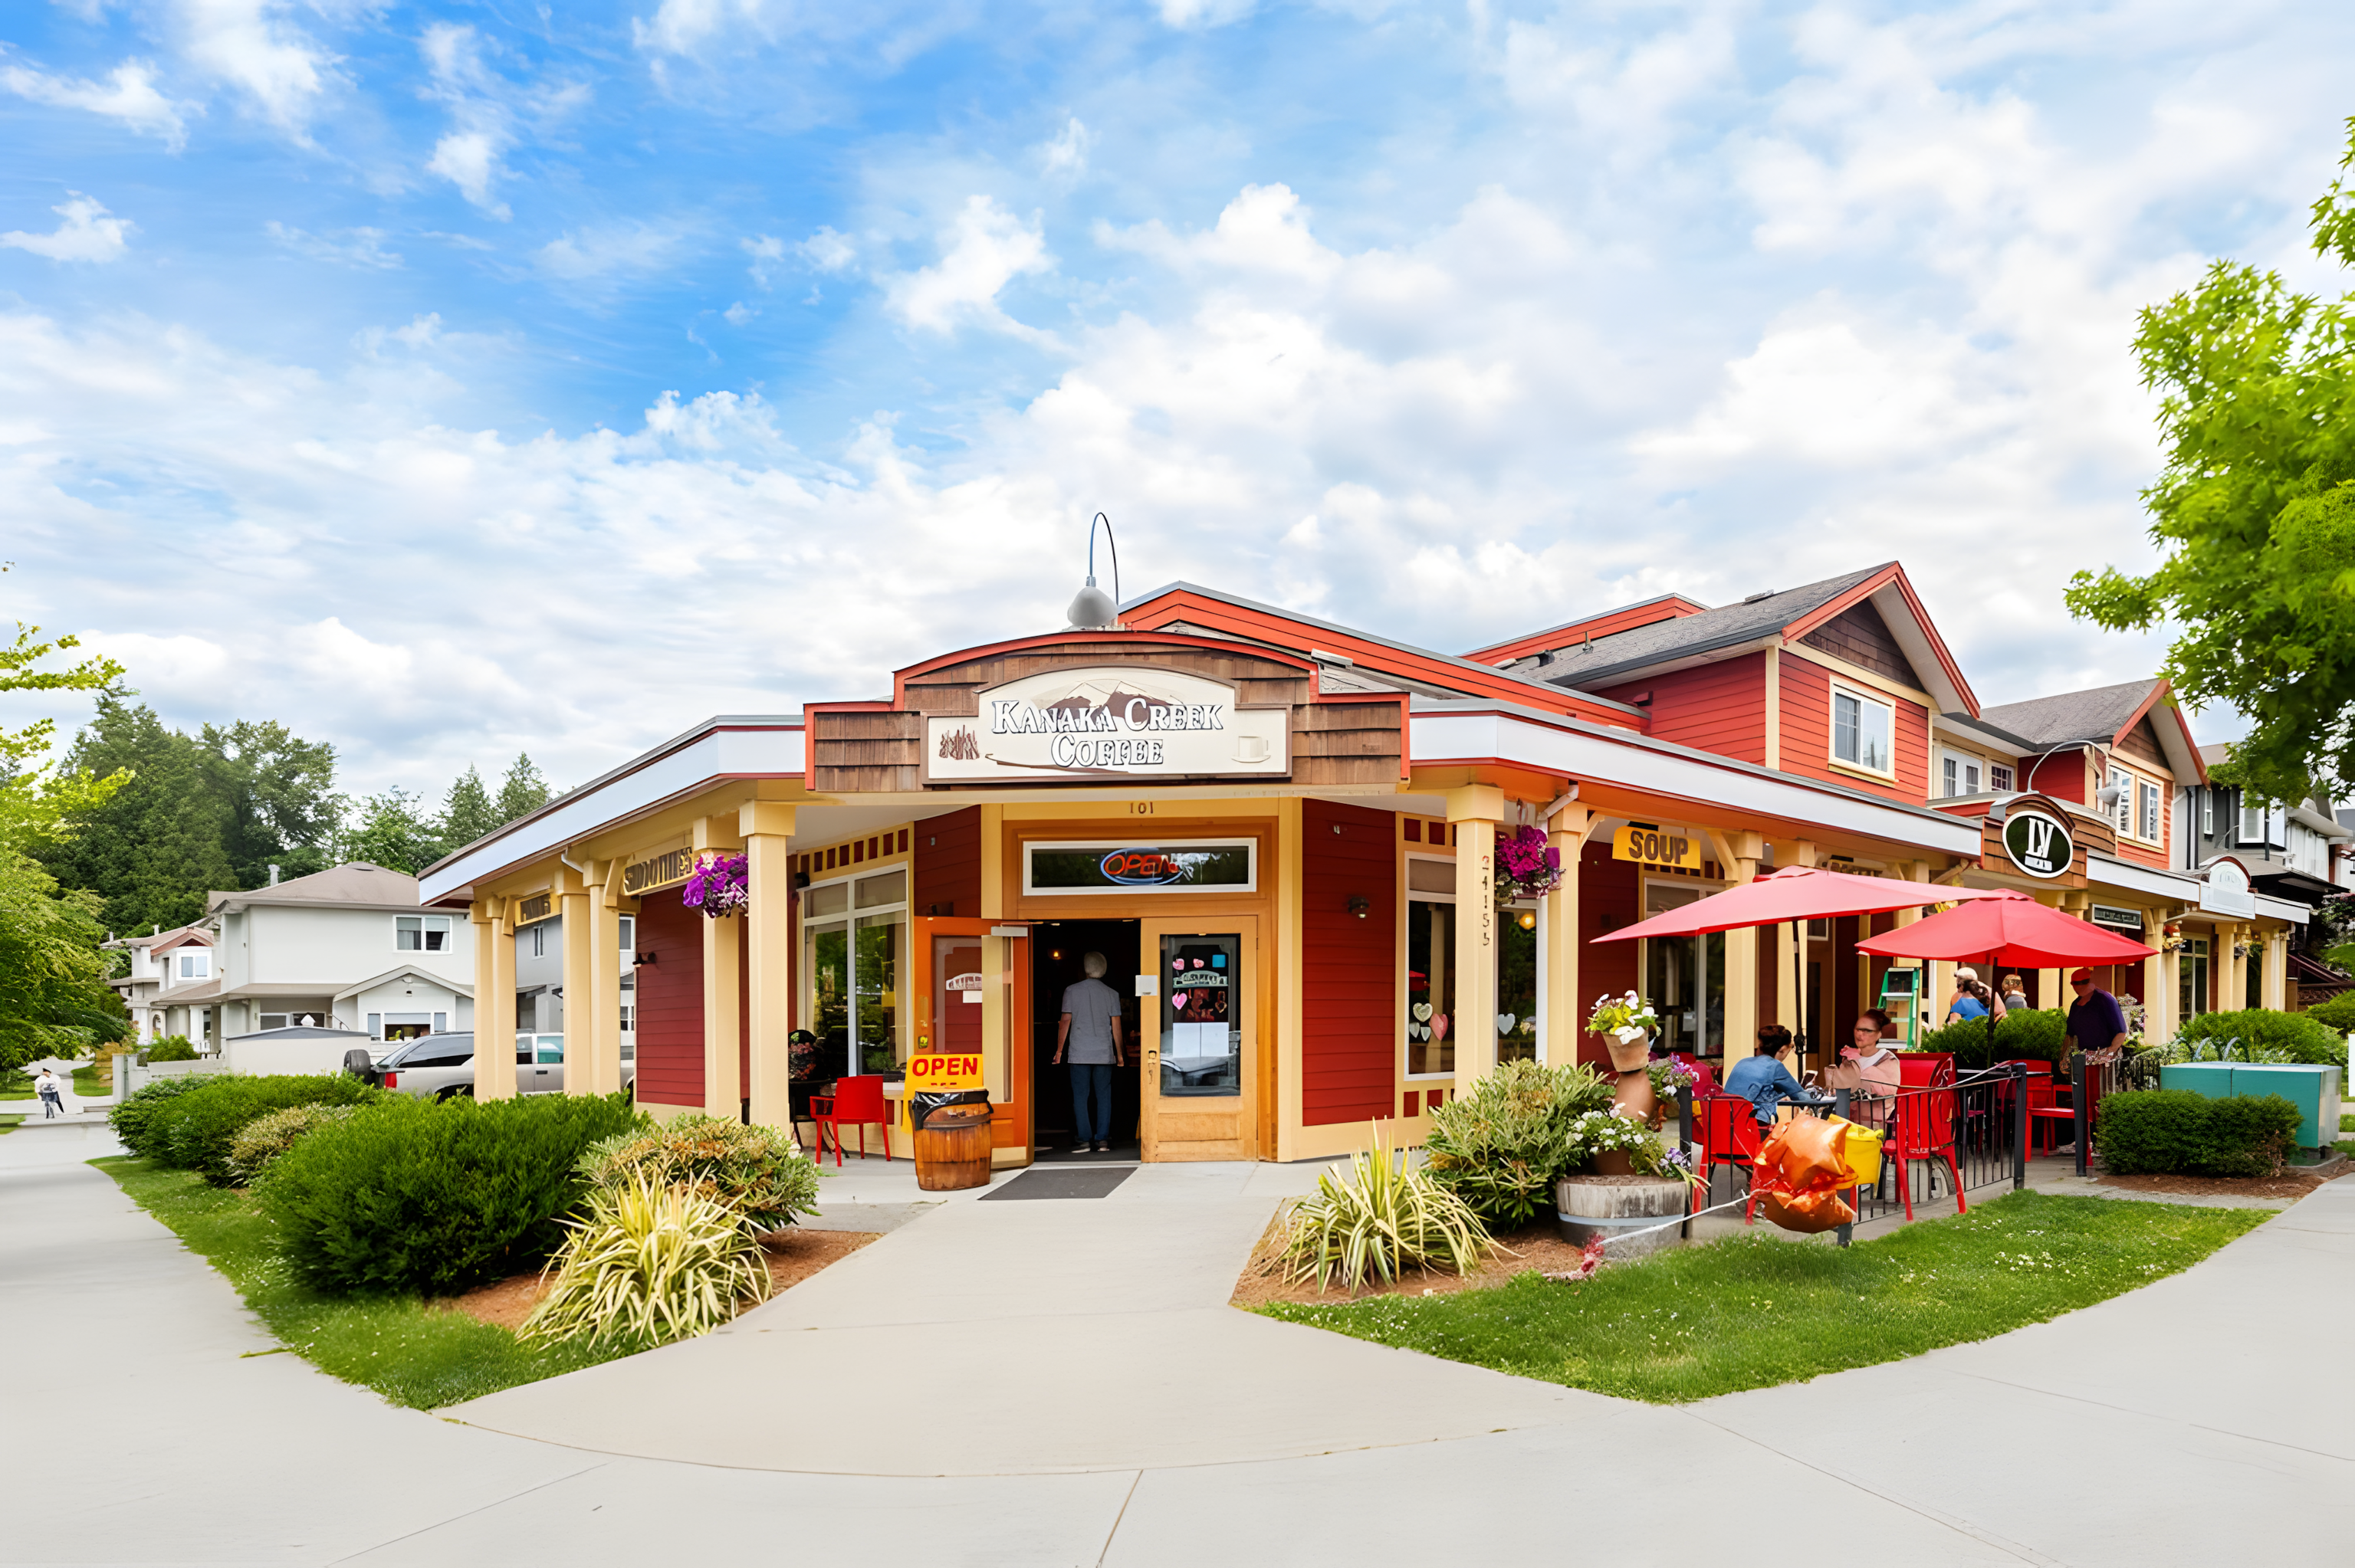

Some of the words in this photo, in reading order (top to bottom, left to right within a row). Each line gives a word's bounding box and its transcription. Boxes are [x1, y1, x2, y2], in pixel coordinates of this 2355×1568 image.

[991, 700, 1118, 734] KANAKA
[1125, 697, 1224, 731] CREEK
[1051, 733, 1164, 767] COFFEE
[1130, 802, 1154, 814] 101
[1628, 830, 1689, 864] SOUP
[1104, 854, 1178, 875] OPEN
[912, 1057, 978, 1077] OPEN
